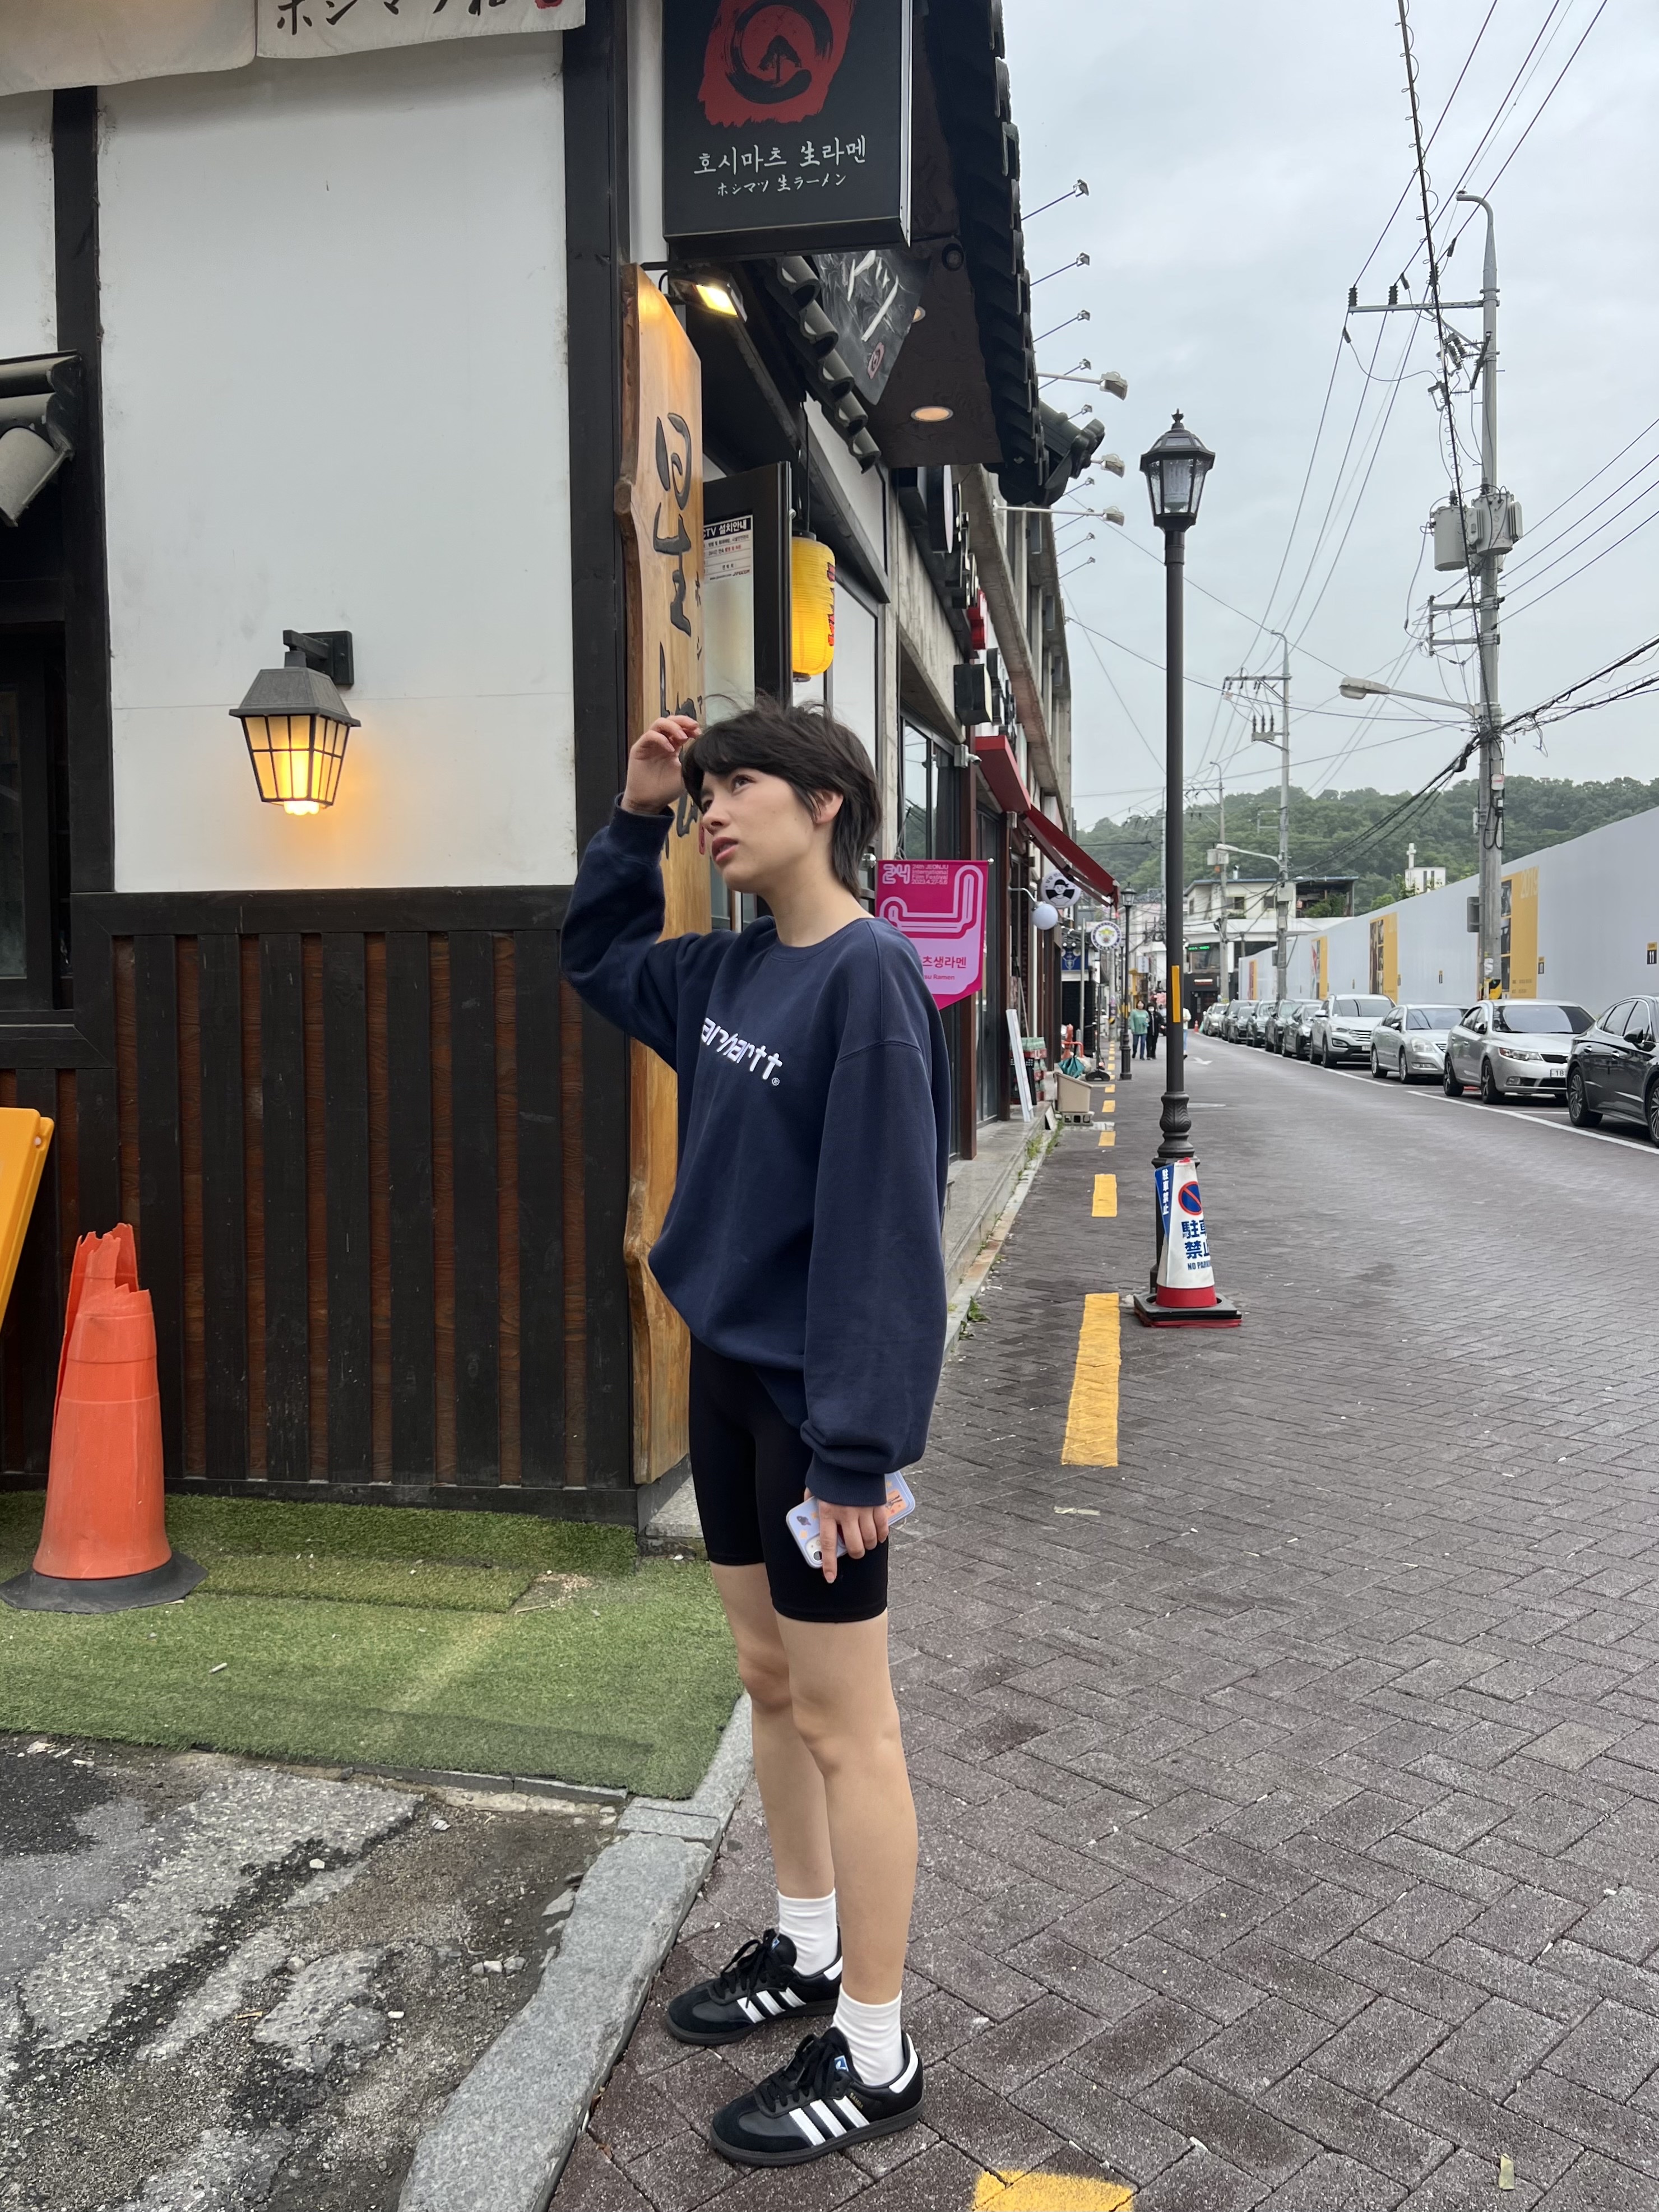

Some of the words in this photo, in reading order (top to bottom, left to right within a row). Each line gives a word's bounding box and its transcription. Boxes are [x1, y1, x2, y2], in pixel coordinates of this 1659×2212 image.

[694, 144, 787, 175] 호시마츠
[799, 135, 866, 168] 生라멘
[717, 179, 770, 197] ホシマツ
[777, 173, 847, 192] 生ラーメン
[922, 956, 967, 969] 츠생라멘
[1649, 950, 1655, 964] 11
[701, 1017, 783, 1080] arhartt
[1187, 1262, 1196, 1270] NO
